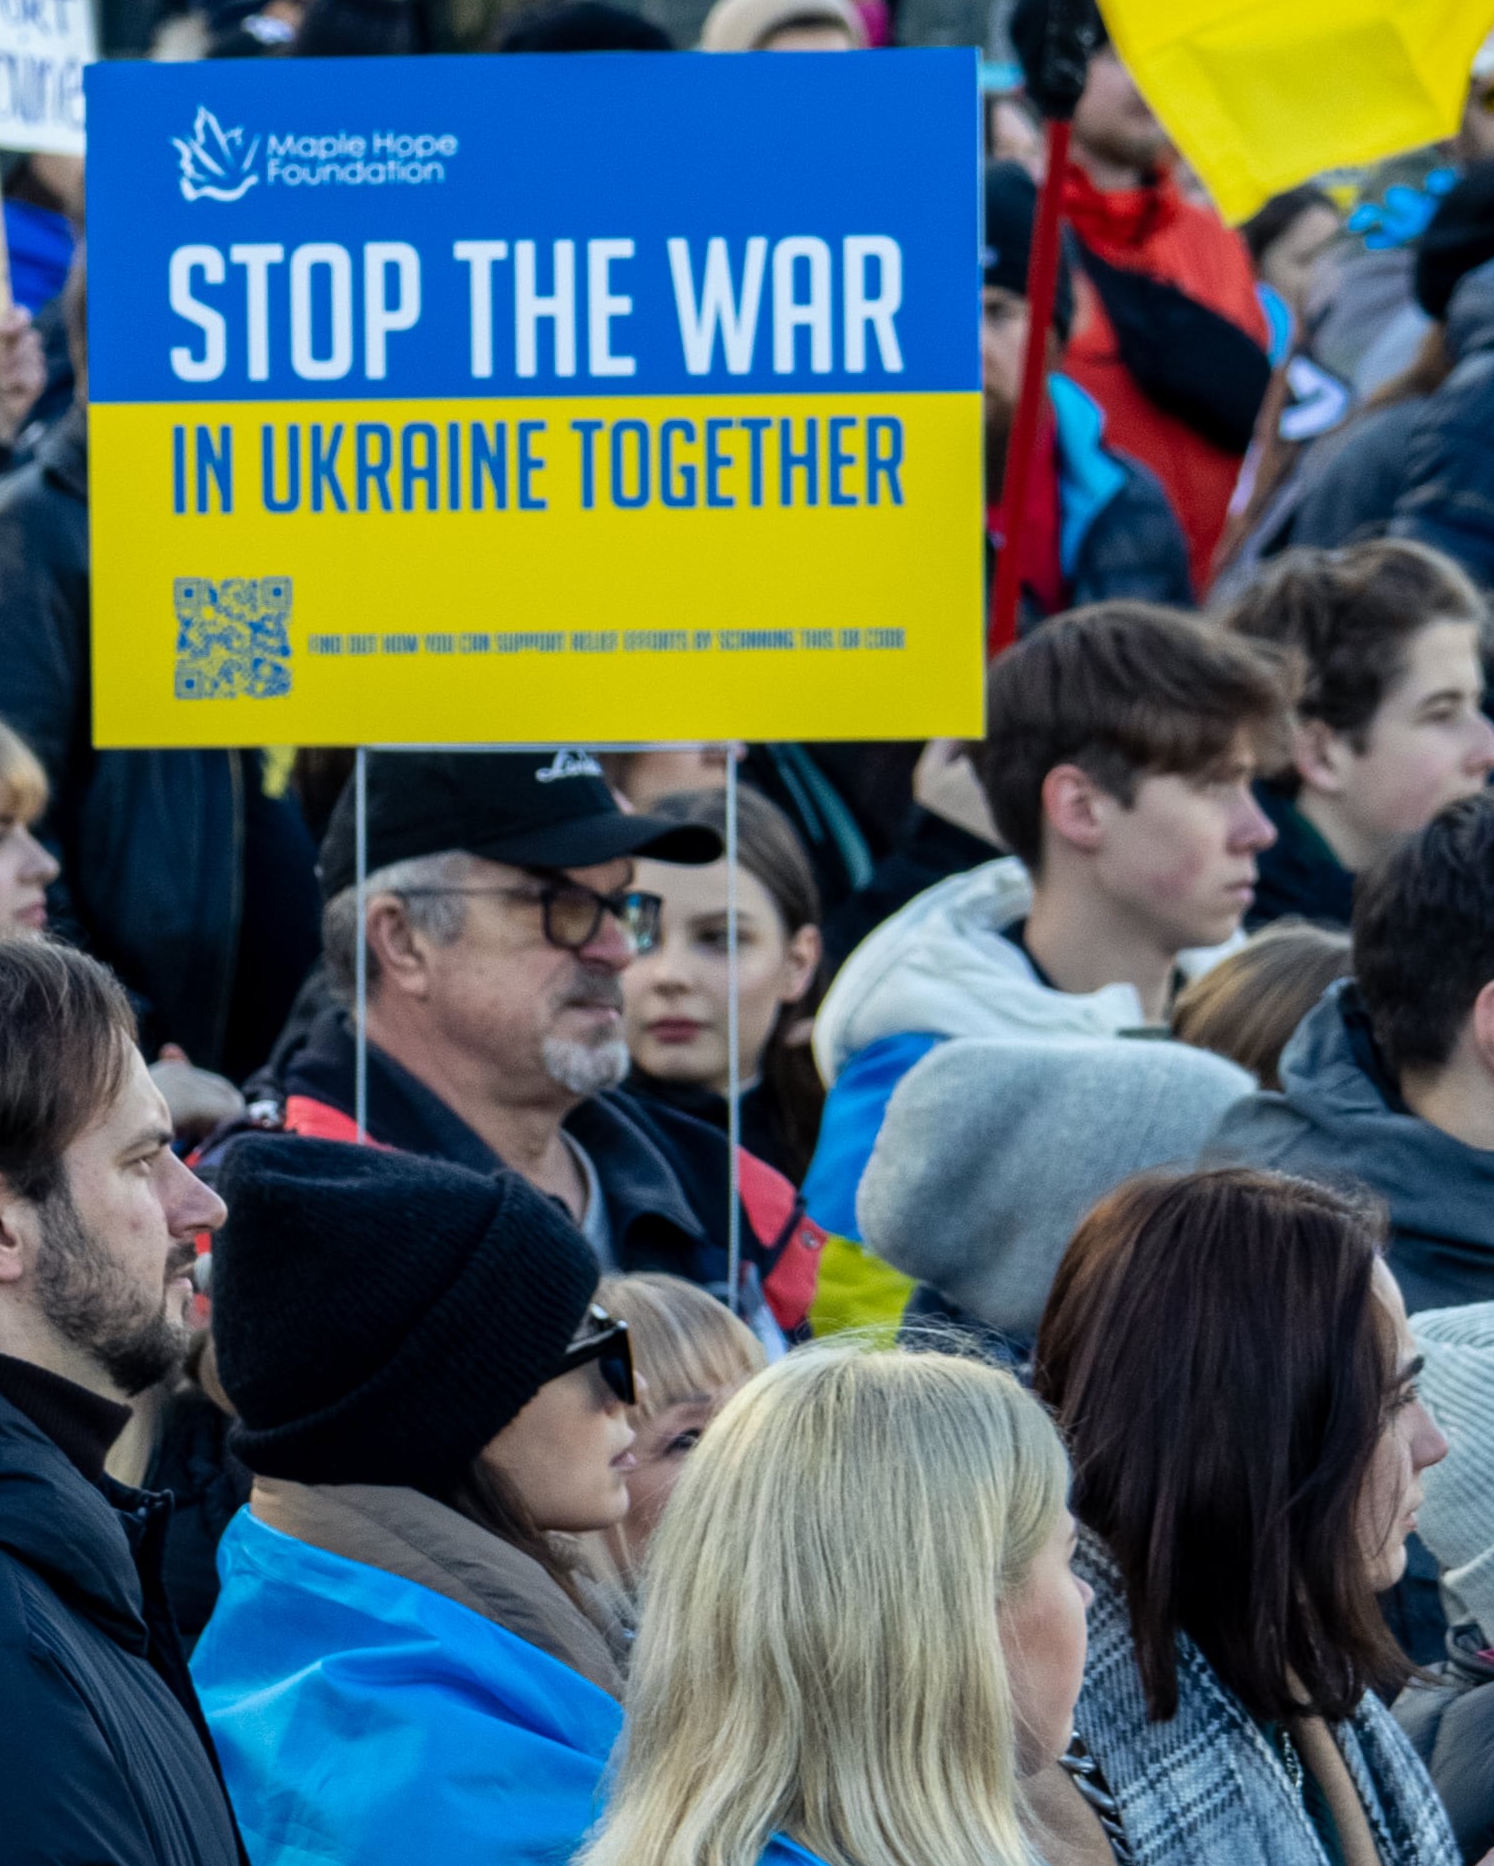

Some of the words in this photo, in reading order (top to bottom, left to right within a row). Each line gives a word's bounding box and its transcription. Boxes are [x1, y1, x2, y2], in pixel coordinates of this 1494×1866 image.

[268, 133, 366, 162] Maple
[373, 131, 458, 161] Hope
[268, 156, 444, 184] Foundation
[169, 243, 421, 382] STOP
[453, 239, 636, 378] THE
[667, 235, 903, 375] WAR
[172, 423, 234, 515] IN
[260, 419, 549, 515] UKRAINE
[569, 414, 905, 511] TOGETHER
